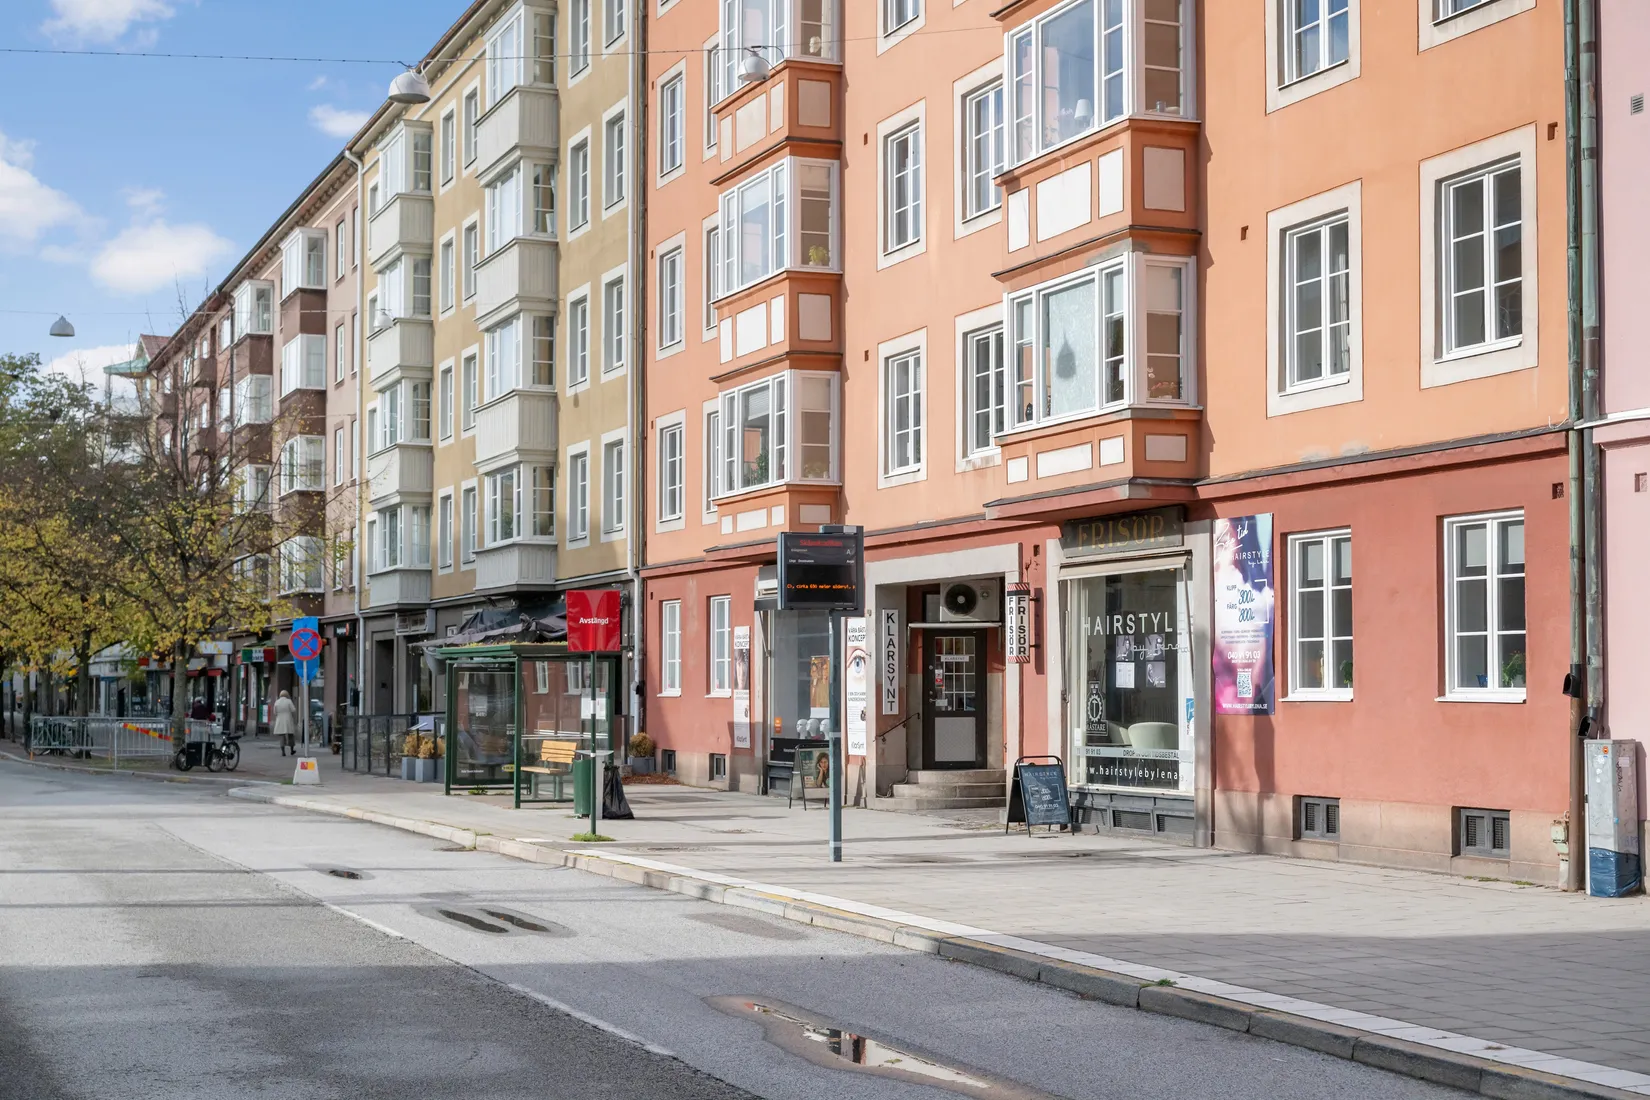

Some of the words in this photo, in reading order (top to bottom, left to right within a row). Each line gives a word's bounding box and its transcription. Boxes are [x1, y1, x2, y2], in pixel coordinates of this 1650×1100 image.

[1078, 514, 1165, 550] FRISÖR
[1231, 549, 1270, 561] HAIRSTYLE
[578, 616, 610, 626] Avstängd
[1017, 596, 1027, 656] FRISÖR
[1227, 651, 1238, 660] 040
[1246, 651, 1253, 659] 91
[1253, 650, 1261, 659] 03
[886, 612, 897, 712] KLARSYNT
[1123, 749, 1136, 757] DROP
